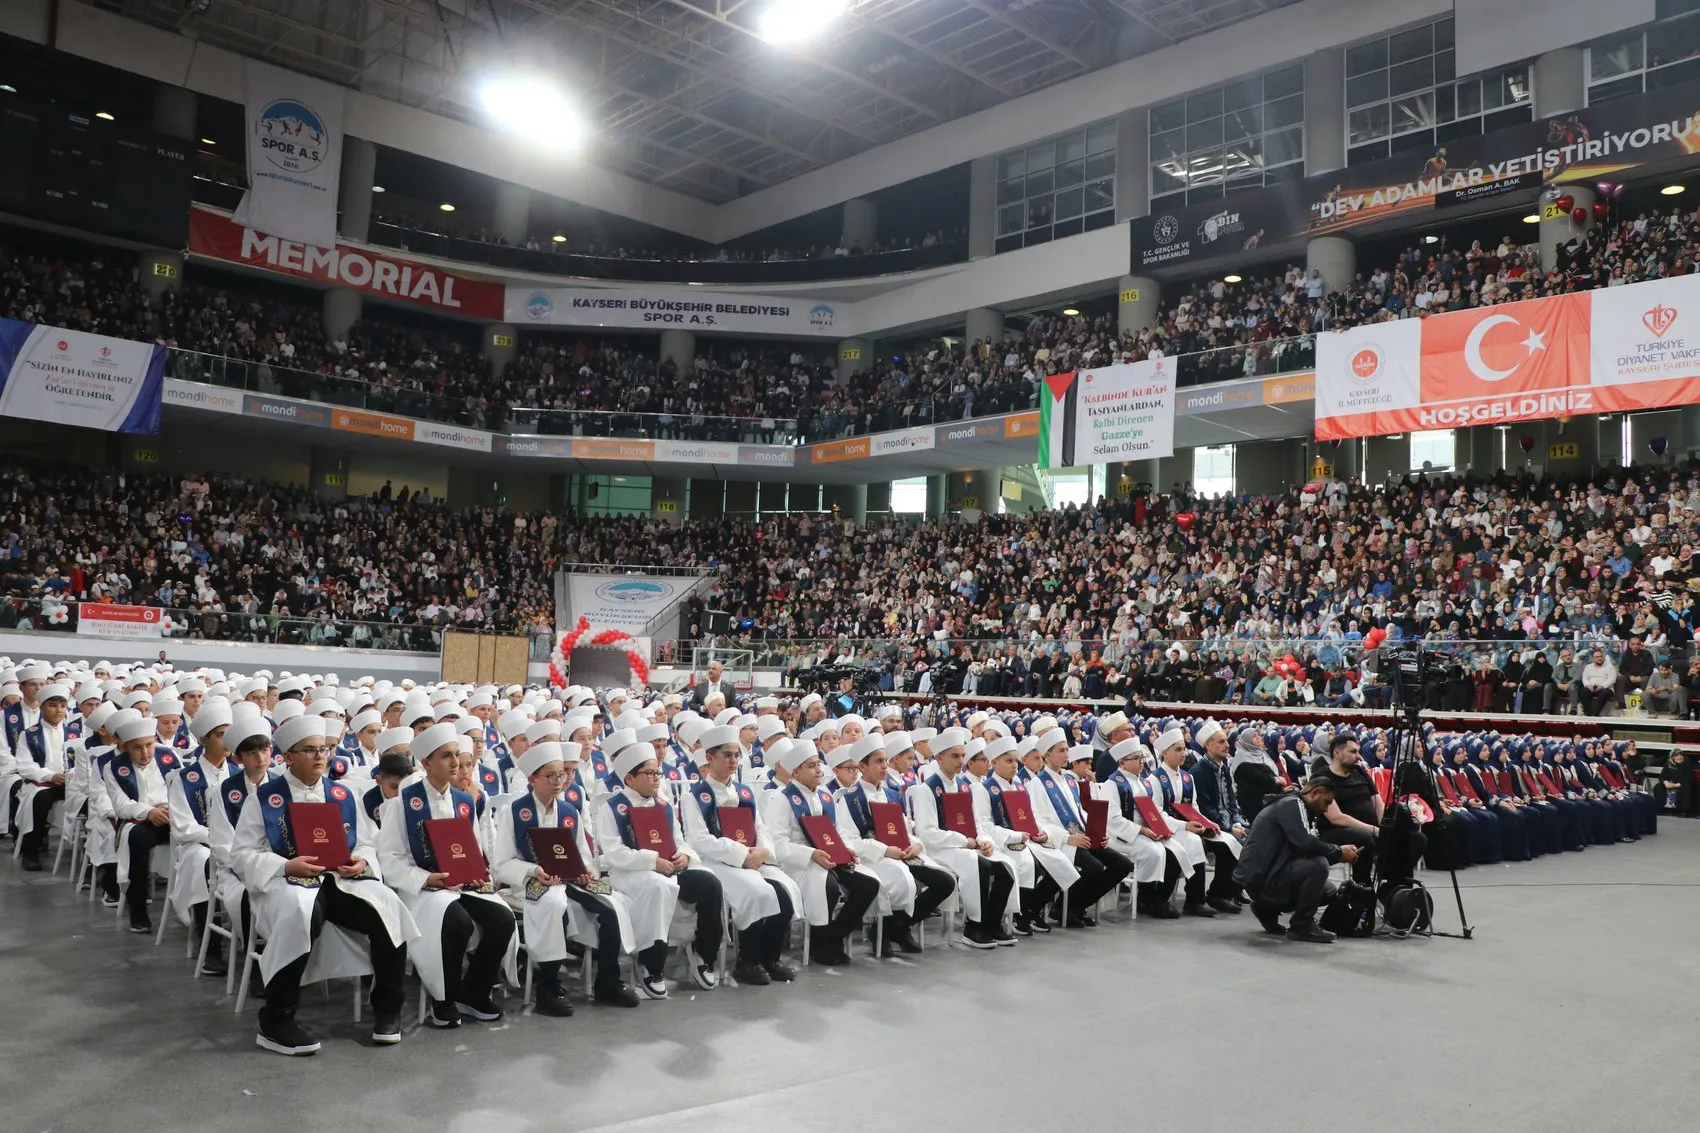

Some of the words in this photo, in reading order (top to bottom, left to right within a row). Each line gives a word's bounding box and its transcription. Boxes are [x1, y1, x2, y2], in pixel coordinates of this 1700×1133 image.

[262, 137, 295, 155] SPOR
[157, 148, 185, 161] PLAYER
[1370, 167, 1484, 207] ADAMLAR
[1467, 184, 1493, 195] Osman
[1503, 177, 1520, 187] BAK
[45, 189, 64, 199] SCORE
[1546, 206, 1561, 218] 21
[1143, 250, 1154, 258] T.C.
[1181, 241, 1190, 249] VE
[1142, 257, 1158, 265] SPOR
[1158, 248, 1190, 261] BAKANLIĞI
[155, 264, 176, 277] 220
[240, 227, 461, 308] MEMORIAL
[1121, 290, 1137, 302] 216
[572, 297, 627, 310] KAYSERİ
[630, 298, 713, 314] BÜYÜKŞEHİR
[715, 303, 790, 317] BELEDİYESİ
[643, 312, 684, 323] SPOR
[689, 315, 717, 327] A.Ş.
[495, 335, 512, 347] 219
[1635, 338, 1685, 353] TÜRKİYE
[842, 350, 858, 359] 217
[1617, 352, 1666, 367] DİYANET
[1670, 348, 1700, 360] VAKF
[61, 365, 75, 375] EN
[77, 367, 134, 385] HAYIRLINIZ
[167, 386, 235, 408] mondihome
[1349, 386, 1380, 398] KAYSERİ
[1420, 390, 1593, 427] HOŞGELDİNİZ
[1093, 417, 1115, 429] Kalbi
[1117, 414, 1154, 427] Direnen
[430, 428, 485, 446] mondihome
[1101, 428, 1144, 441] Gazze'ye
[883, 435, 930, 449] mondihome
[138, 450, 157, 461] 120
[672, 447, 732, 460] mondihome
[1093, 443, 1120, 455] Selam
[1551, 444, 1574, 457] 114
[1312, 465, 1331, 476] 115
[328, 475, 344, 485] 119
[1118, 483, 1133, 494] 116
[659, 502, 675, 512] 118
